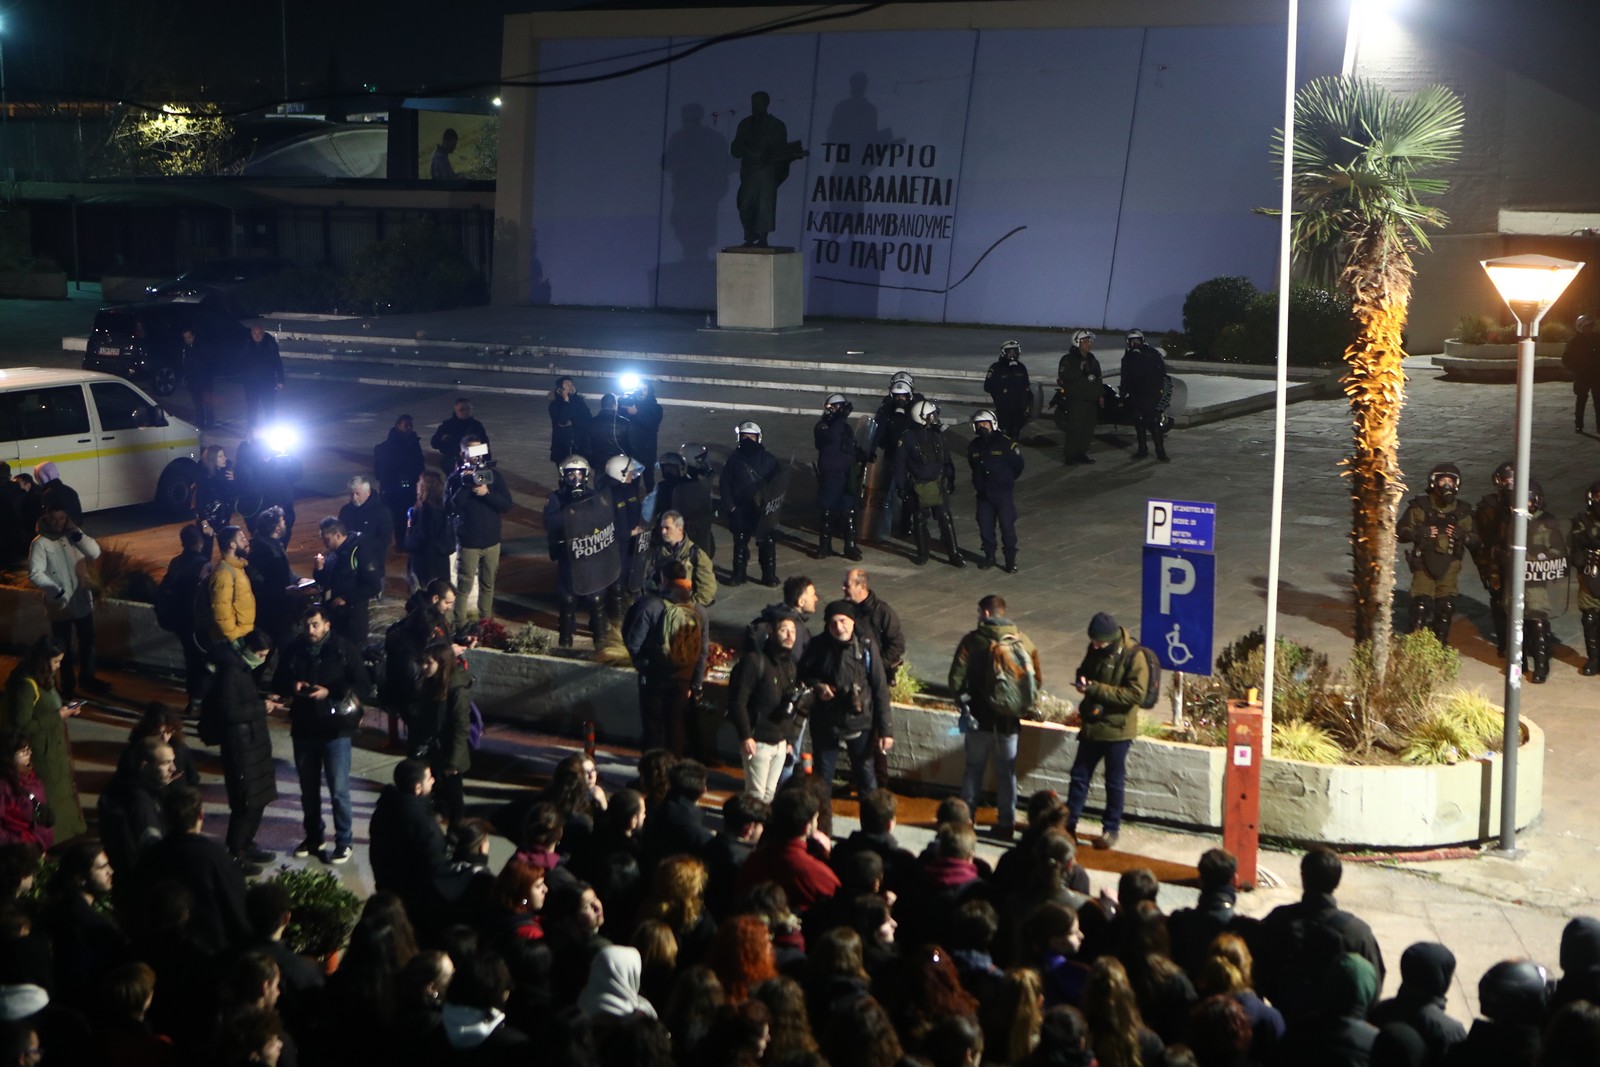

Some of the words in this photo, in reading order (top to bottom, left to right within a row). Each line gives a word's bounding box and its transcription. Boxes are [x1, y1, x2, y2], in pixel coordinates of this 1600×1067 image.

[821, 143, 850, 163] ΤΟ
[861, 143, 936, 168] ΑΥΡΙΟ
[811, 175, 953, 206] ΑΝΑΒΑΛΛΕΤΑΙ
[806, 211, 953, 239] ΚΑΤΑΛΑΜΒΑΝΟΥΜΕ
[812, 238, 840, 264] ΤΟ
[849, 241, 933, 275] ΠΑΡΟΝ
[1151, 506, 1167, 540] P
[575, 532, 616, 559] POLICE
[1523, 568, 1564, 581] OLICE
[1524, 557, 1567, 573] ΤΥΝΟΜΙΑ
[1159, 555, 1196, 615] P
